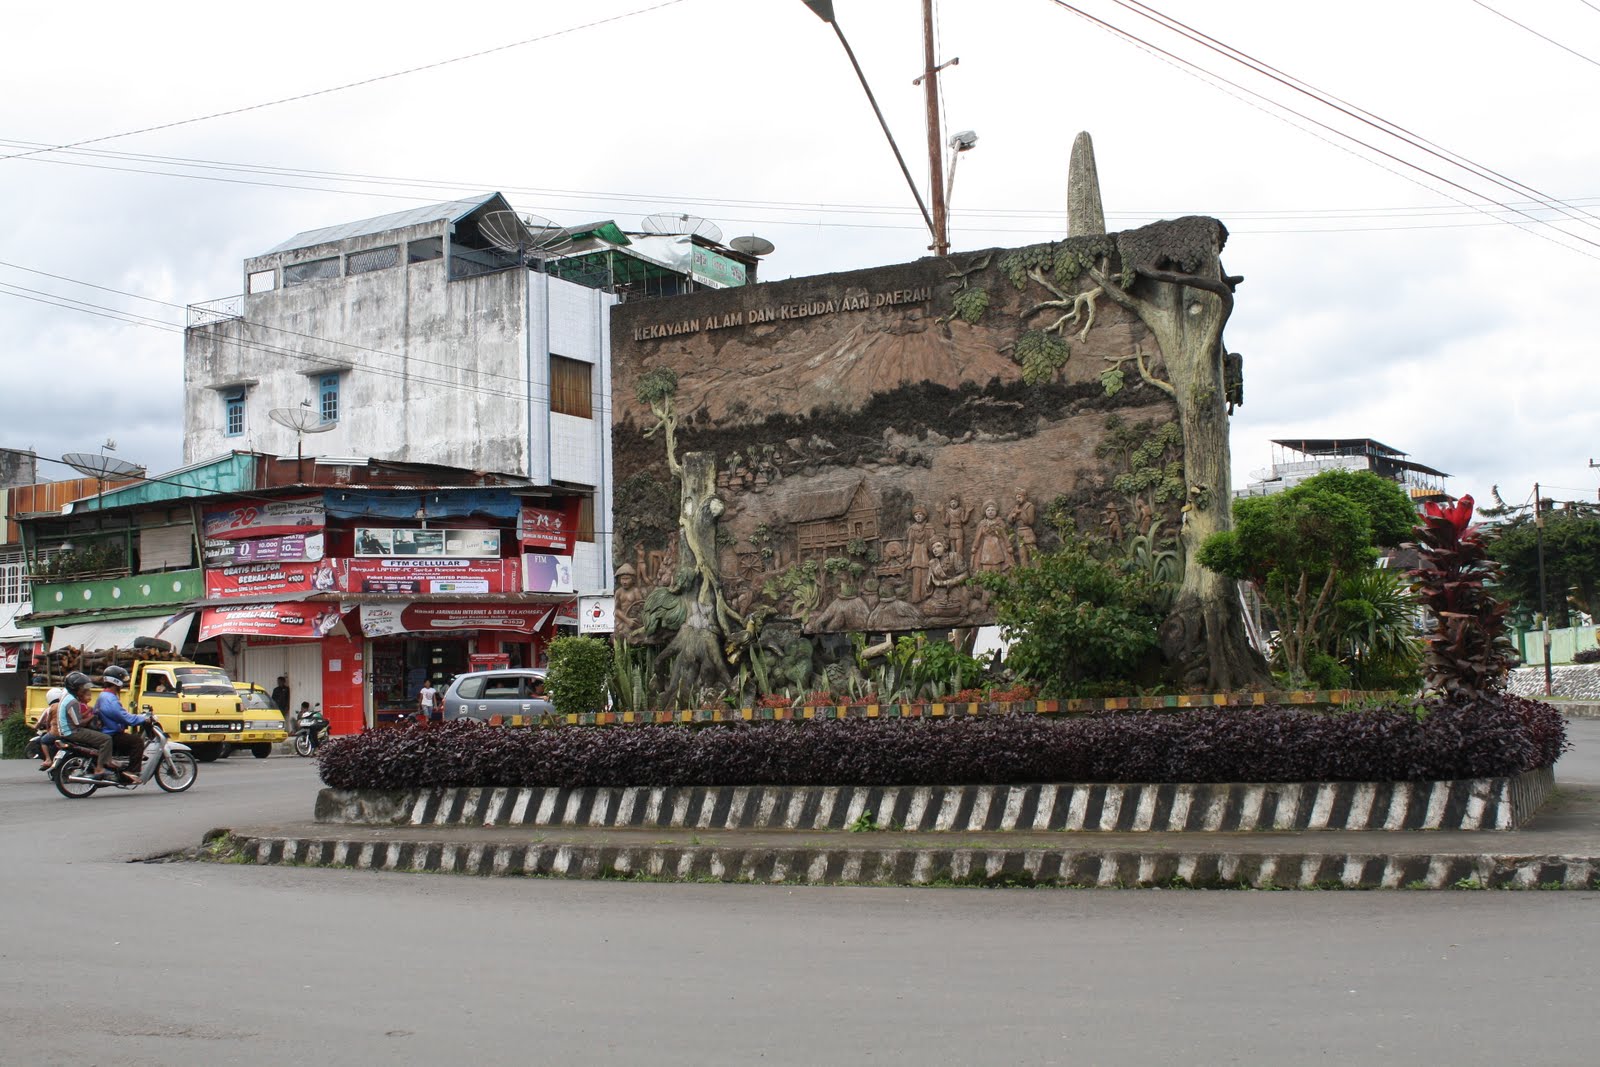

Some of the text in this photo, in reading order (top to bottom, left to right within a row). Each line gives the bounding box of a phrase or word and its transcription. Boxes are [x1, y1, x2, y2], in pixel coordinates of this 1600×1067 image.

[633, 286, 932, 341] KEKAYAAN ALAM DAN KEBUDAYAAN DAERAH
[230, 507, 258, 528] 20
[220, 547, 236, 556] AXIS
[281, 544, 292, 552] 10
[534, 555, 548, 564] FTM
[223, 563, 281, 576] GRATIS NELPON
